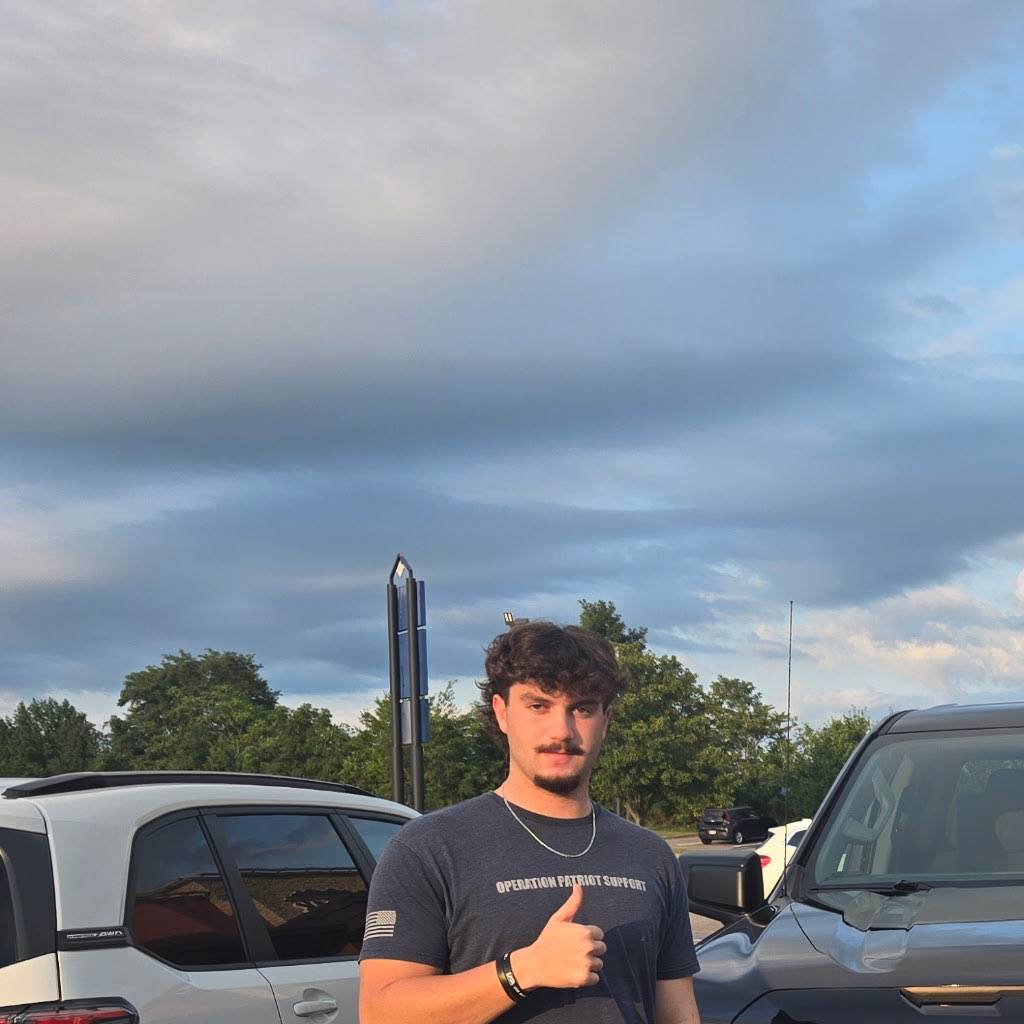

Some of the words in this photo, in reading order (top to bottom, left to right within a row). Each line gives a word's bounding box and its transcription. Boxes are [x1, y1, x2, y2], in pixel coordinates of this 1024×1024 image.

[496, 876, 557, 894] OPERATION
[557, 875, 602, 888] PATRIOT
[603, 875, 647, 892] SUPPORT
